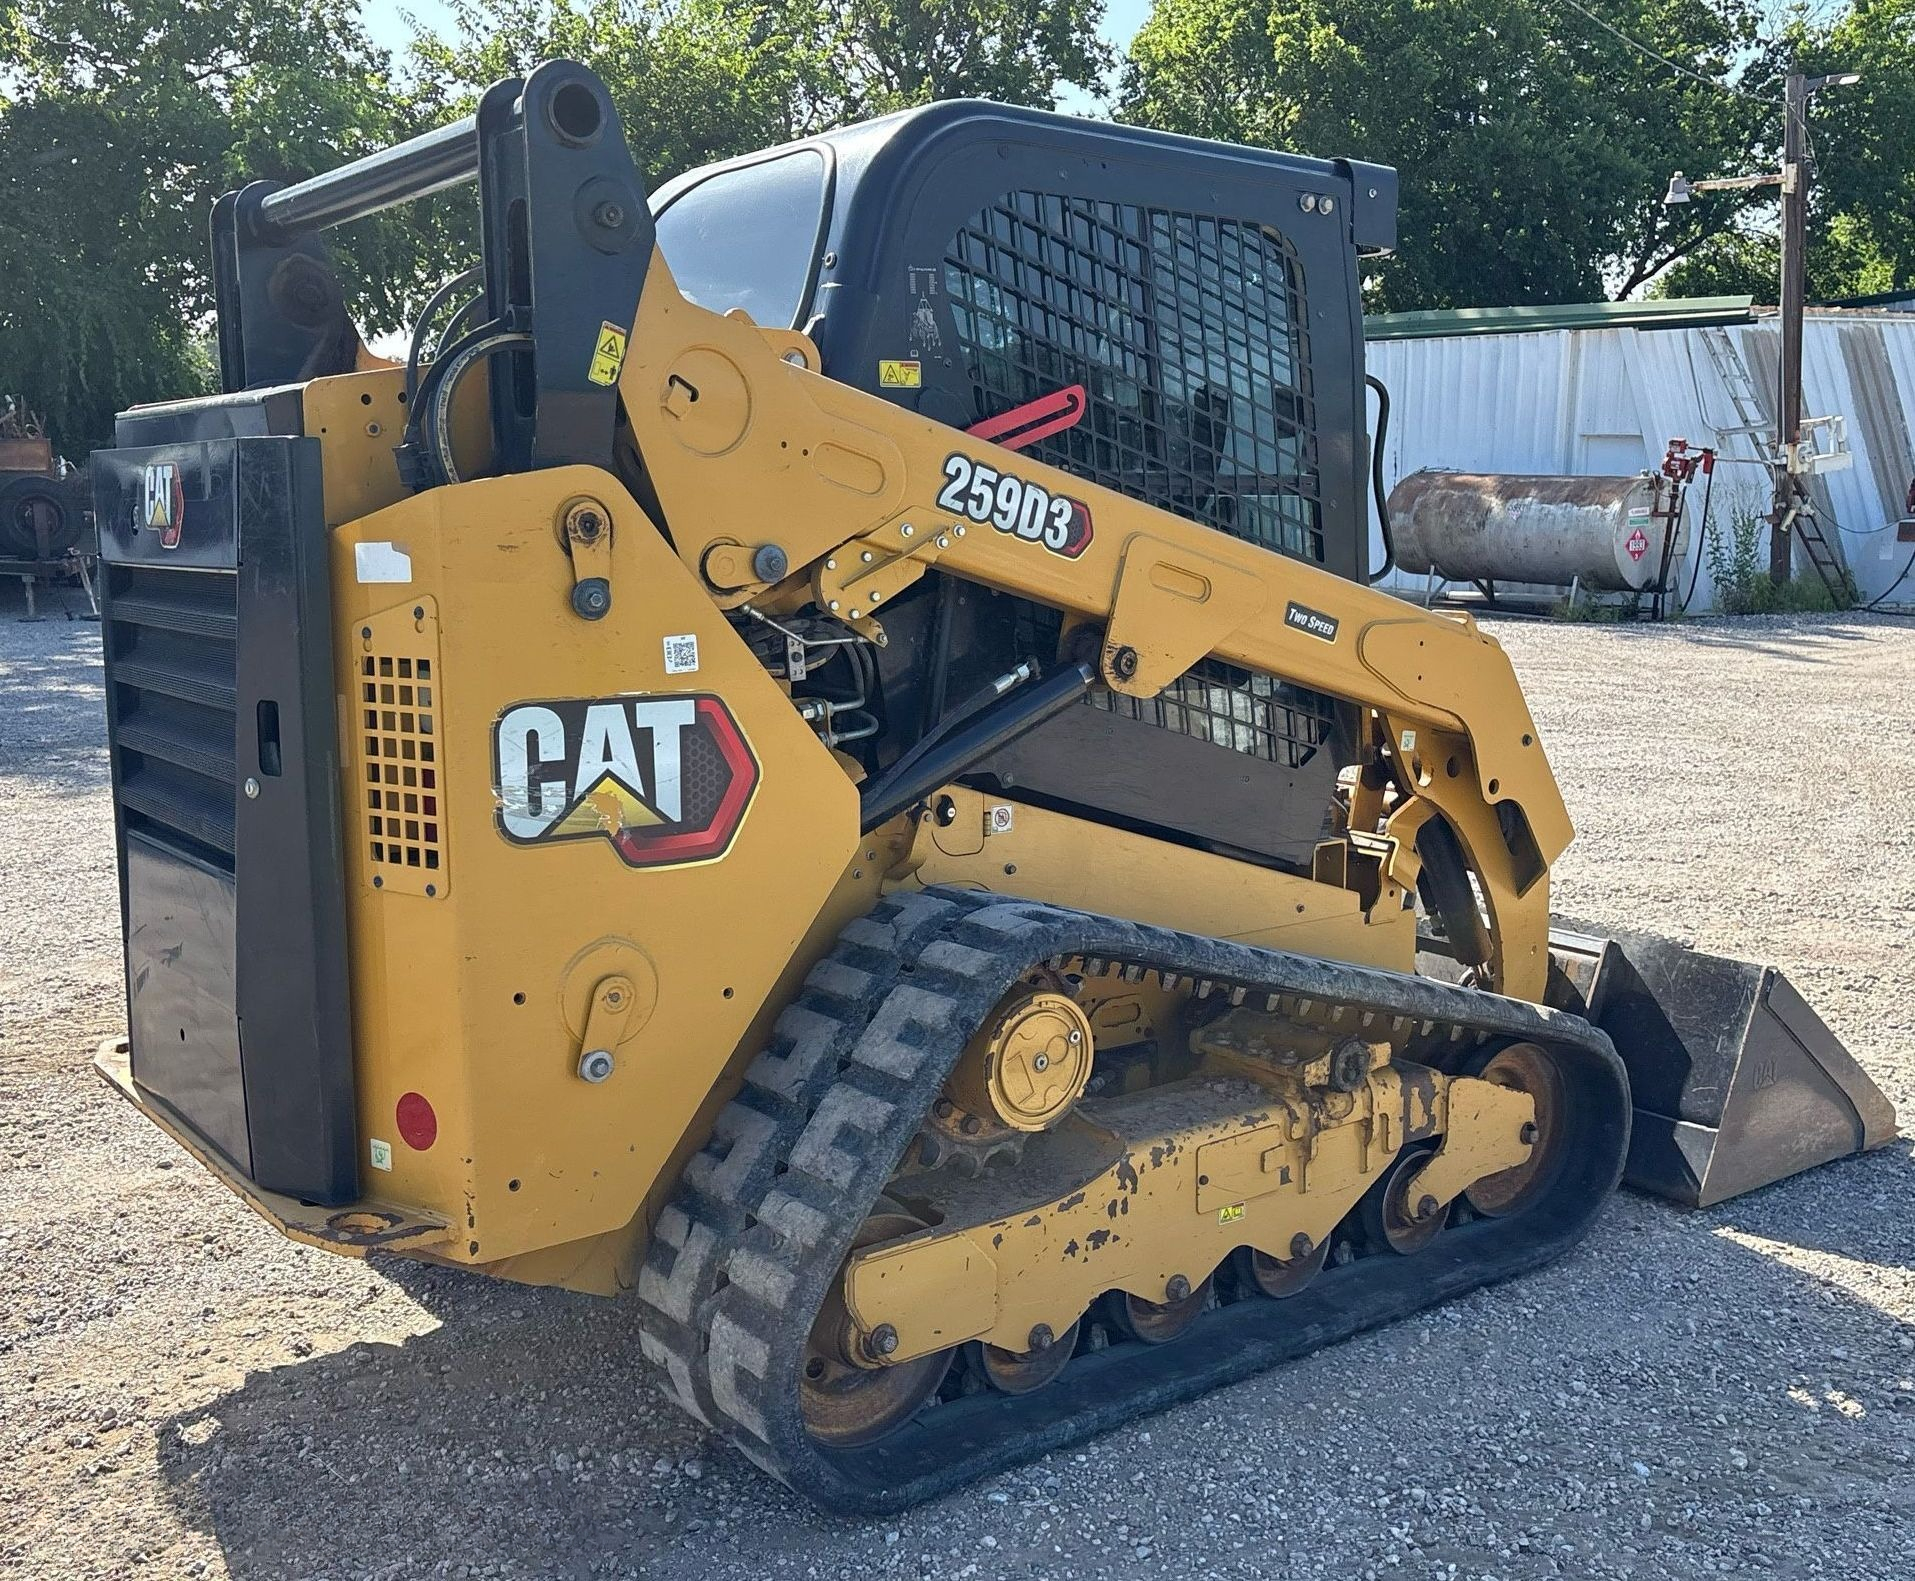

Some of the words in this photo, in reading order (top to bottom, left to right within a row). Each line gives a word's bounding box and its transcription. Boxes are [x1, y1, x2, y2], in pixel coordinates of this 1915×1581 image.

[145, 465, 173, 526] CAT
[938, 456, 1073, 549] 259D3
[1288, 607, 1308, 626] TWO
[1307, 615, 1335, 636] SPEED
[499, 700, 696, 838] CAT
